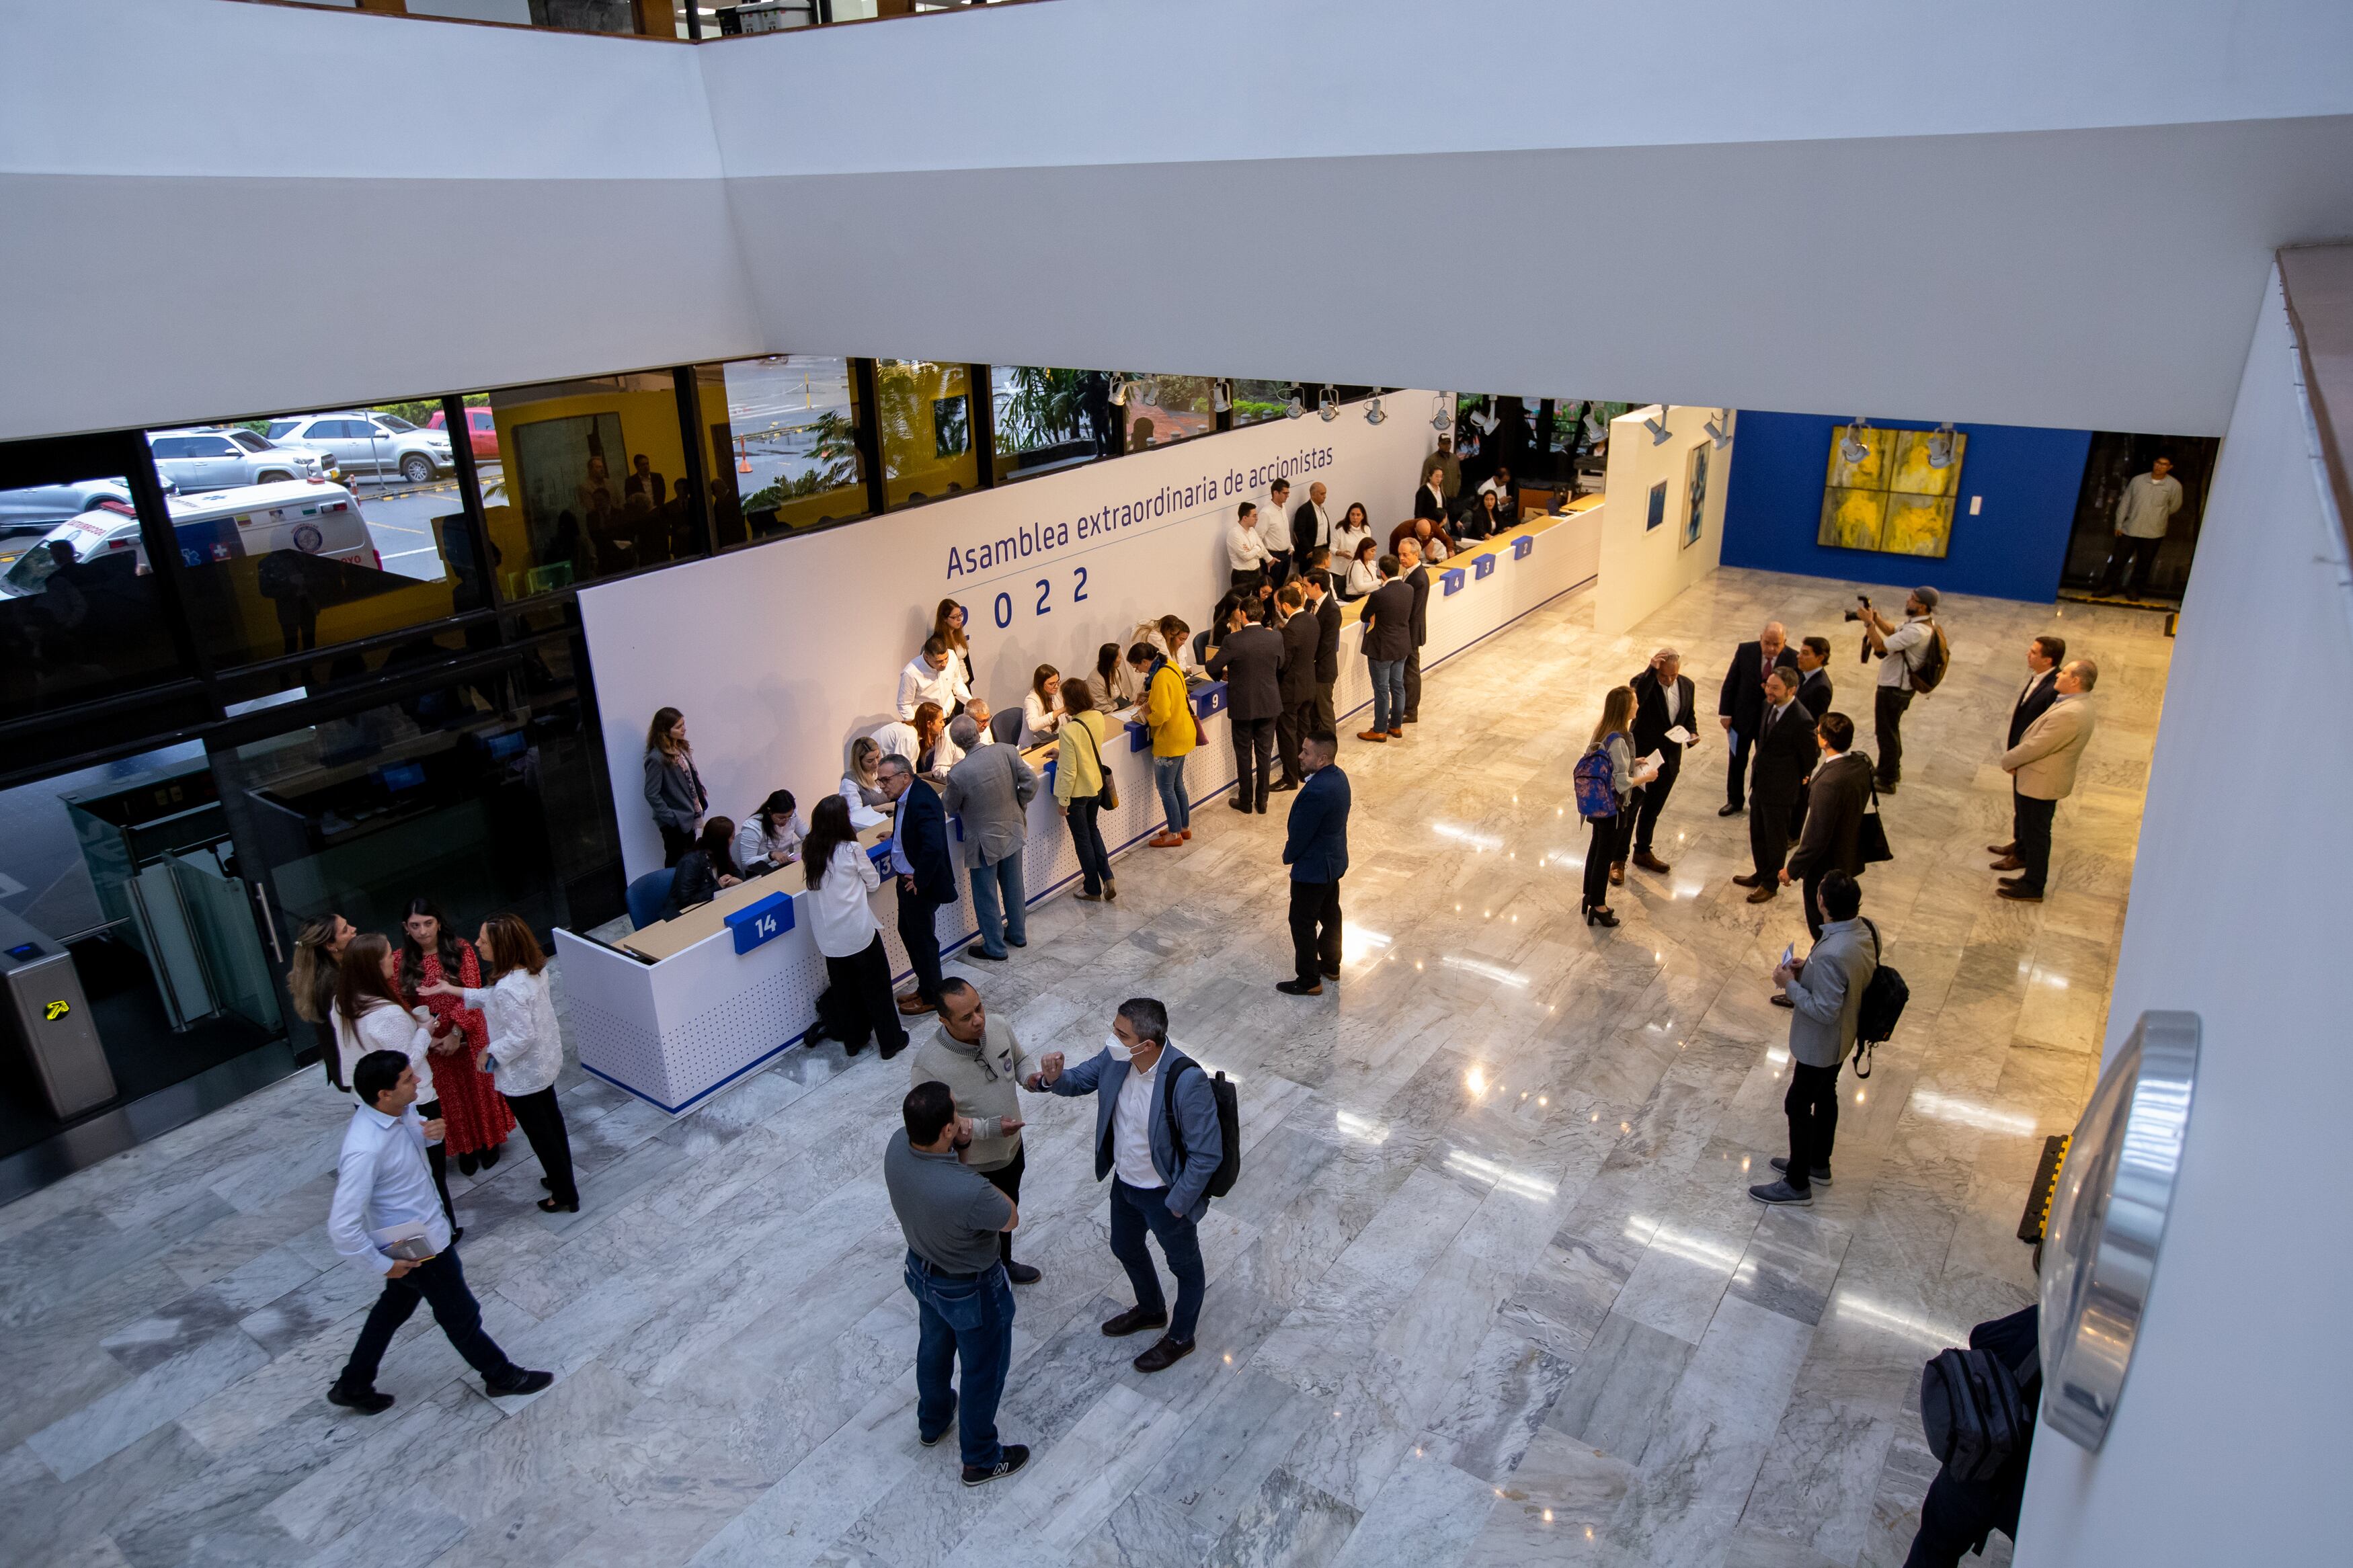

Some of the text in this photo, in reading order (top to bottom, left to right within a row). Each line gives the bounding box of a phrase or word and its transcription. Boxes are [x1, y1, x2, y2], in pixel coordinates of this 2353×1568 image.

[947, 447, 1332, 579] Asamblea extraordinaria de accionistas
[1522, 542, 1528, 554] 2
[1484, 561, 1490, 573] 3
[1454, 577, 1460, 588] 4
[1212, 694, 1219, 709] 9
[875, 856, 891, 876] 13
[755, 914, 776, 938] 14
